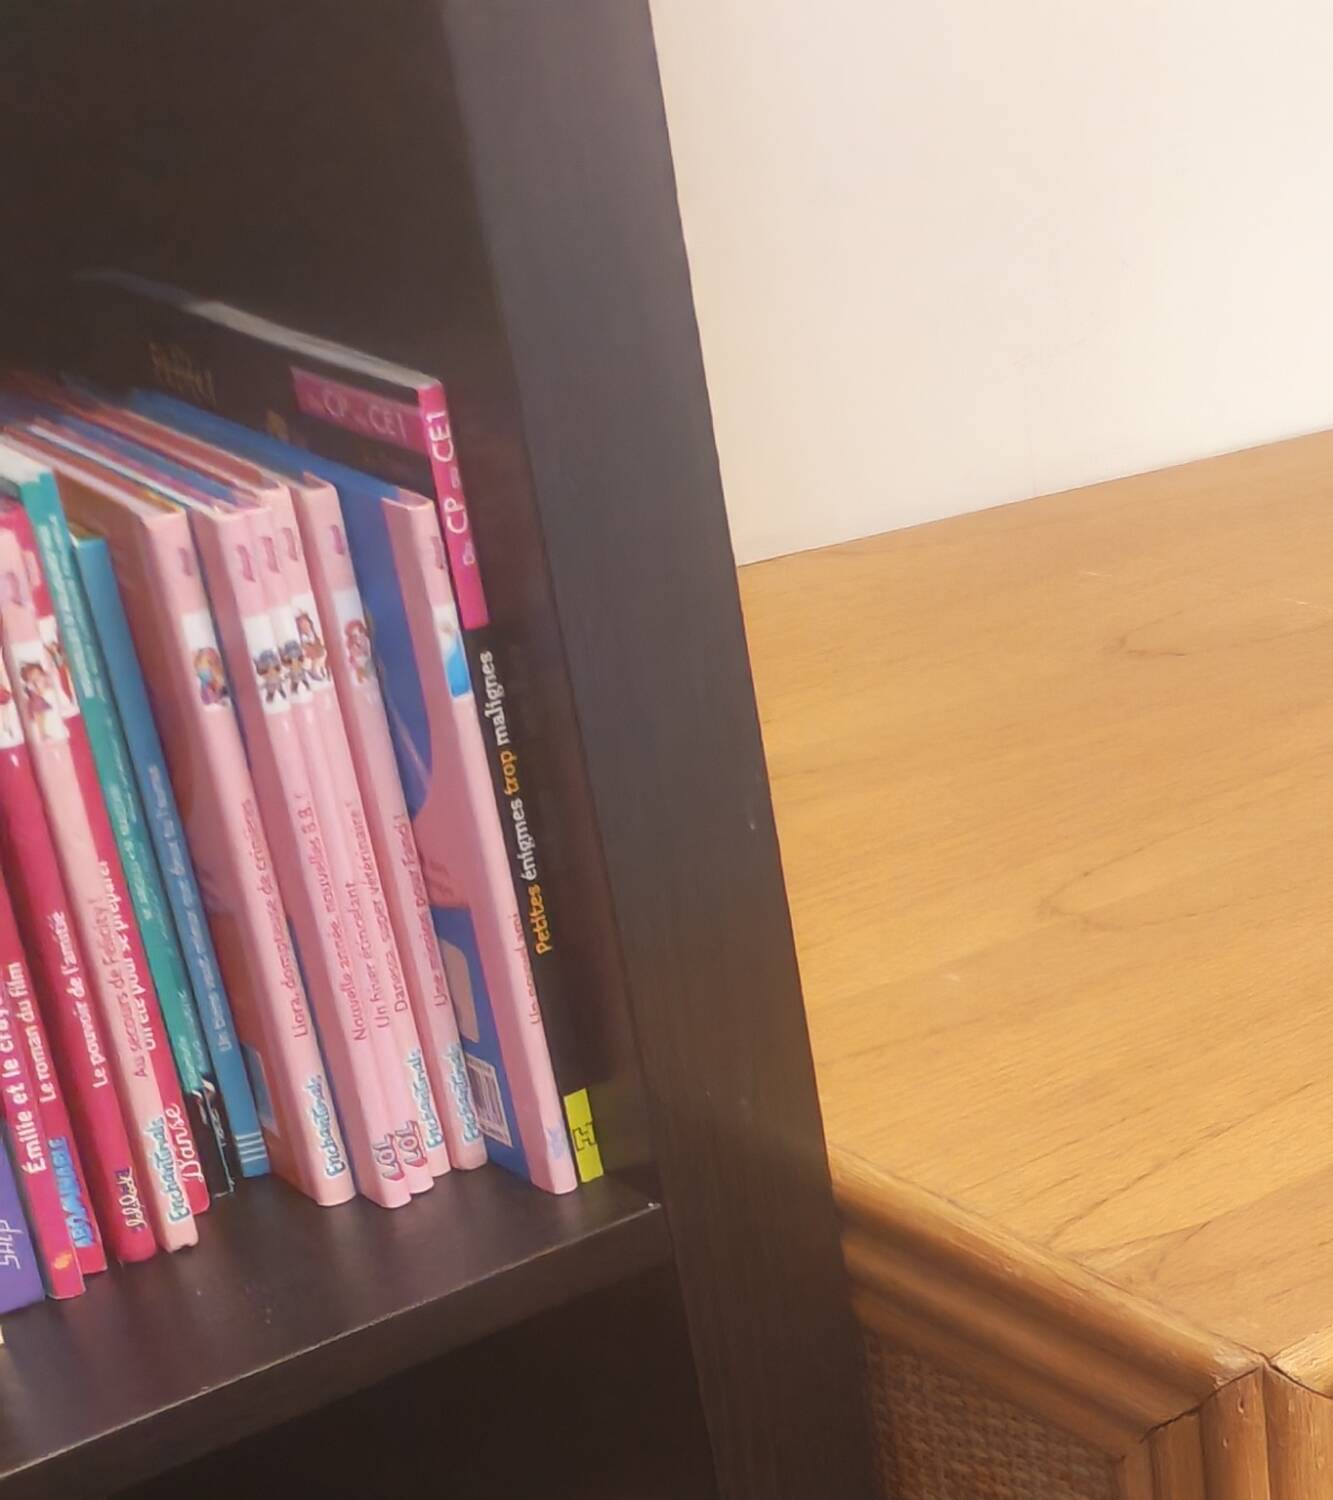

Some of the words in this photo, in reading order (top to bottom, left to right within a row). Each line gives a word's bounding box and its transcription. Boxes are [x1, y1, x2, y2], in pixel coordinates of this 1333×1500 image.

[423, 408, 454, 464] CE1
[441, 494, 470, 535] CP
[472, 649, 514, 746] malignes
[495, 749, 523, 795] trop
[507, 797, 541, 881] énigmes
[254, 874, 272, 897] de
[523, 884, 553, 954] Petites
[3, 961, 27, 998] film
[63, 975, 85, 1000] de
[105, 965, 125, 990] de
[13, 999, 35, 1025] du
[115, 991, 142, 1053] secours
[335, 971, 367, 1042] Nouvelle
[372, 1005, 390, 1029] Un
[24, 1024, 50, 1081] roman
[70, 998, 105, 1066] pouvoir
[0, 1056, 20, 1078] le
[88, 1065, 109, 1088] Le
[130, 1056, 148, 1079] Au
[7, 1081, 28, 1105] et
[36, 1081, 56, 1103] Le
[11, 1109, 47, 1174] Émilie
[160, 1100, 205, 1187] Danse
